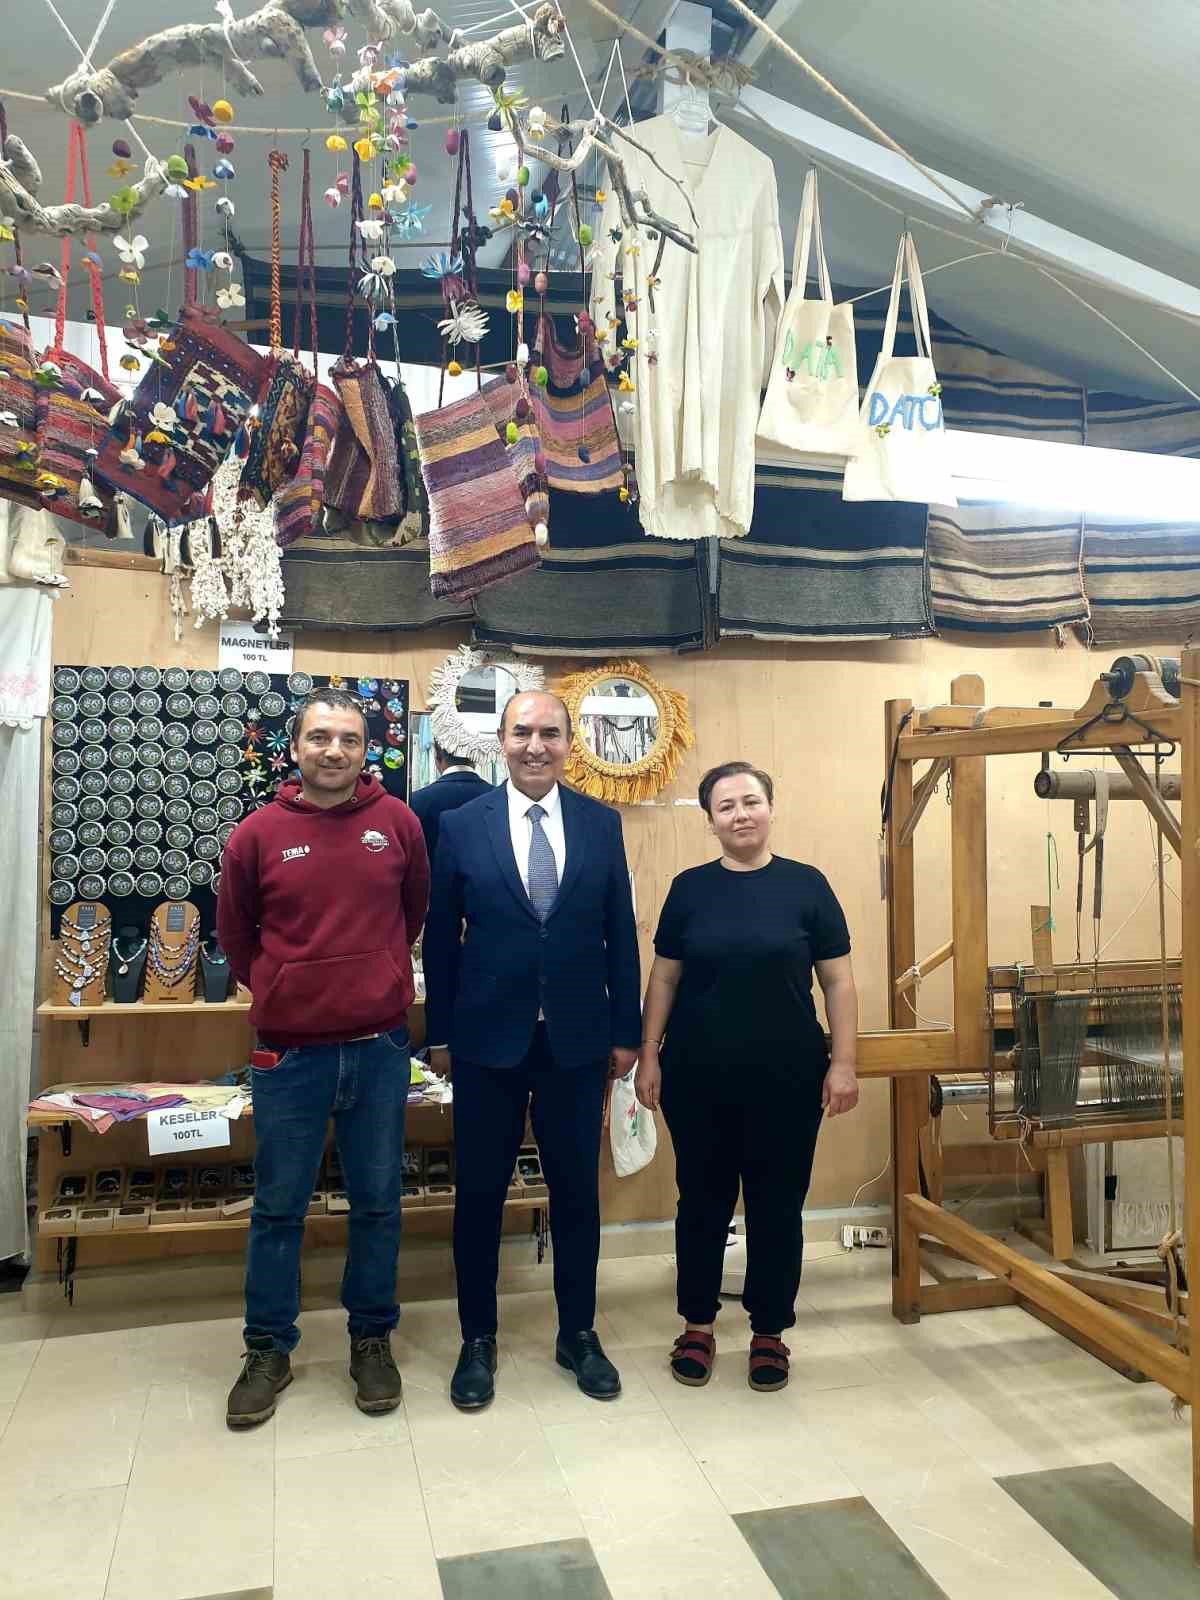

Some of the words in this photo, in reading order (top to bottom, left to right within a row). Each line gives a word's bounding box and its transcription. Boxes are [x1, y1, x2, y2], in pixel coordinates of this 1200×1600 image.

[221, 637, 290, 651] MAGNETLER
[242, 653, 257, 661] 100
[258, 654, 269, 662] TL
[281, 846, 305, 859] TEMA
[159, 1110, 217, 1126] KESELER
[172, 1129, 204, 1140] 100TL
